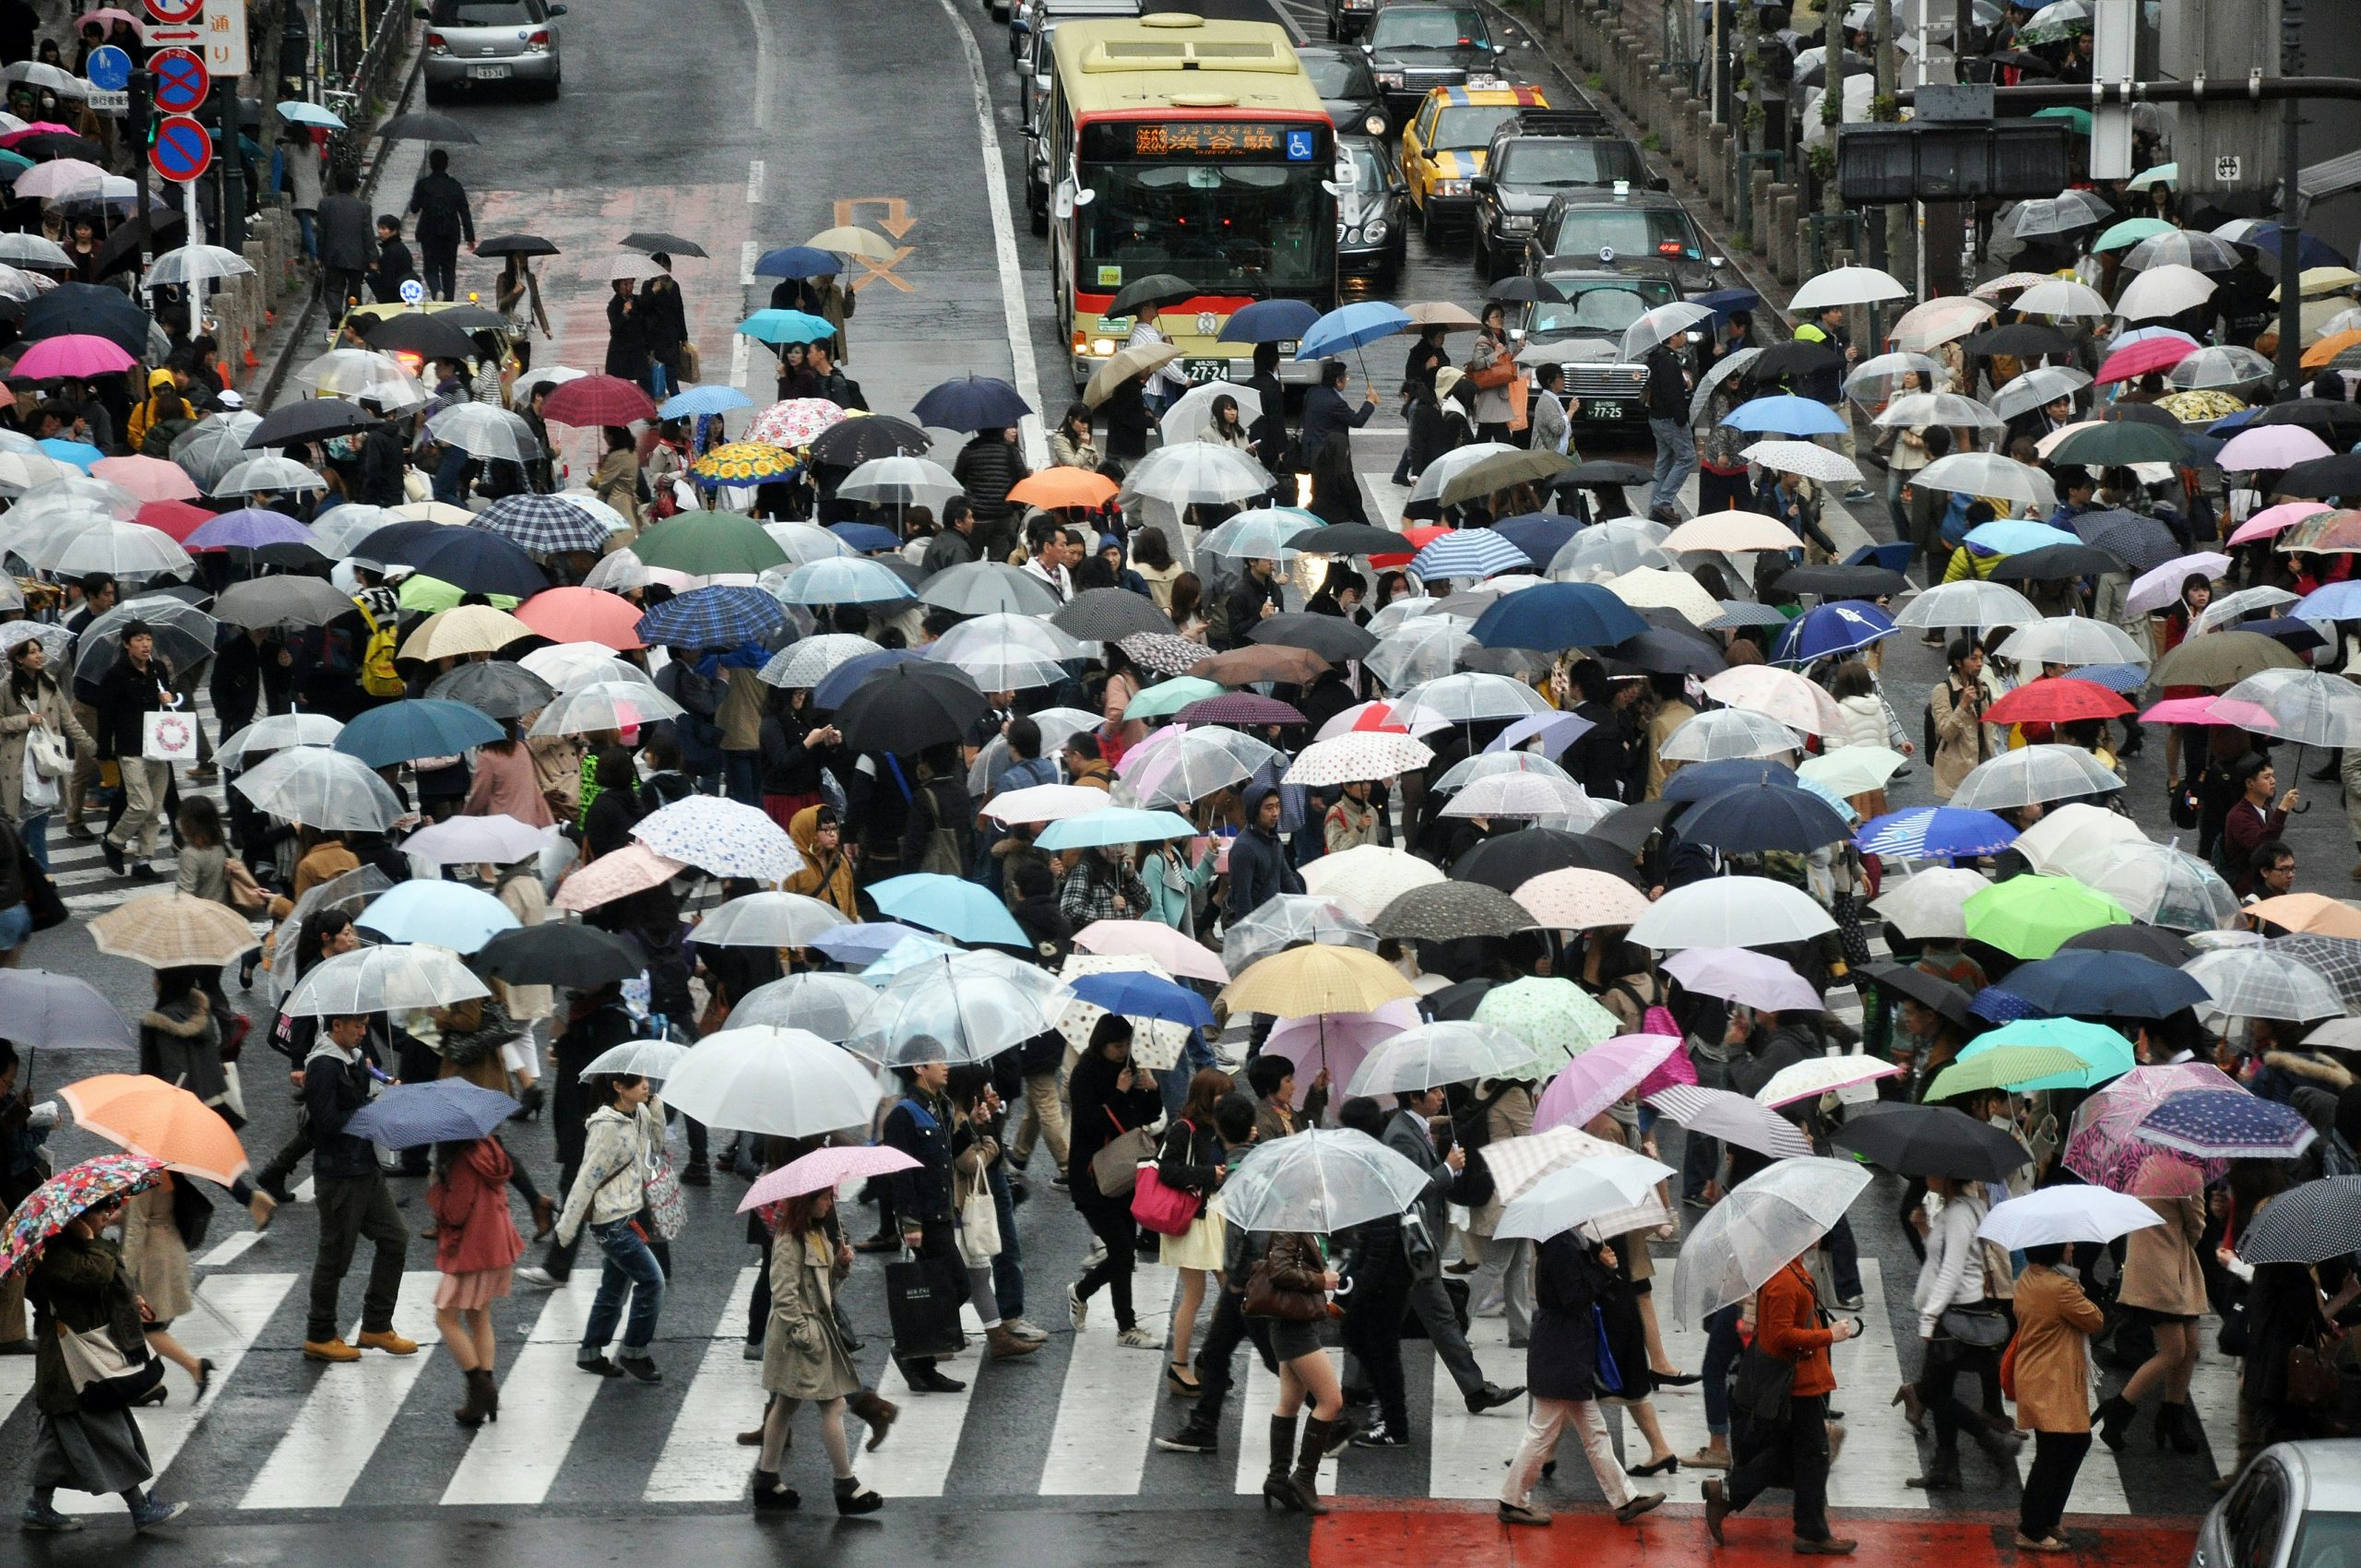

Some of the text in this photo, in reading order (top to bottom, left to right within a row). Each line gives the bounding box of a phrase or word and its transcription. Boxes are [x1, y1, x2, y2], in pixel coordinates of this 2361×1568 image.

[1169, 134, 1274, 149] 渋谷駅
[1191, 366, 1228, 381] 27-24
[1594, 407, 1622, 418] 77-25
